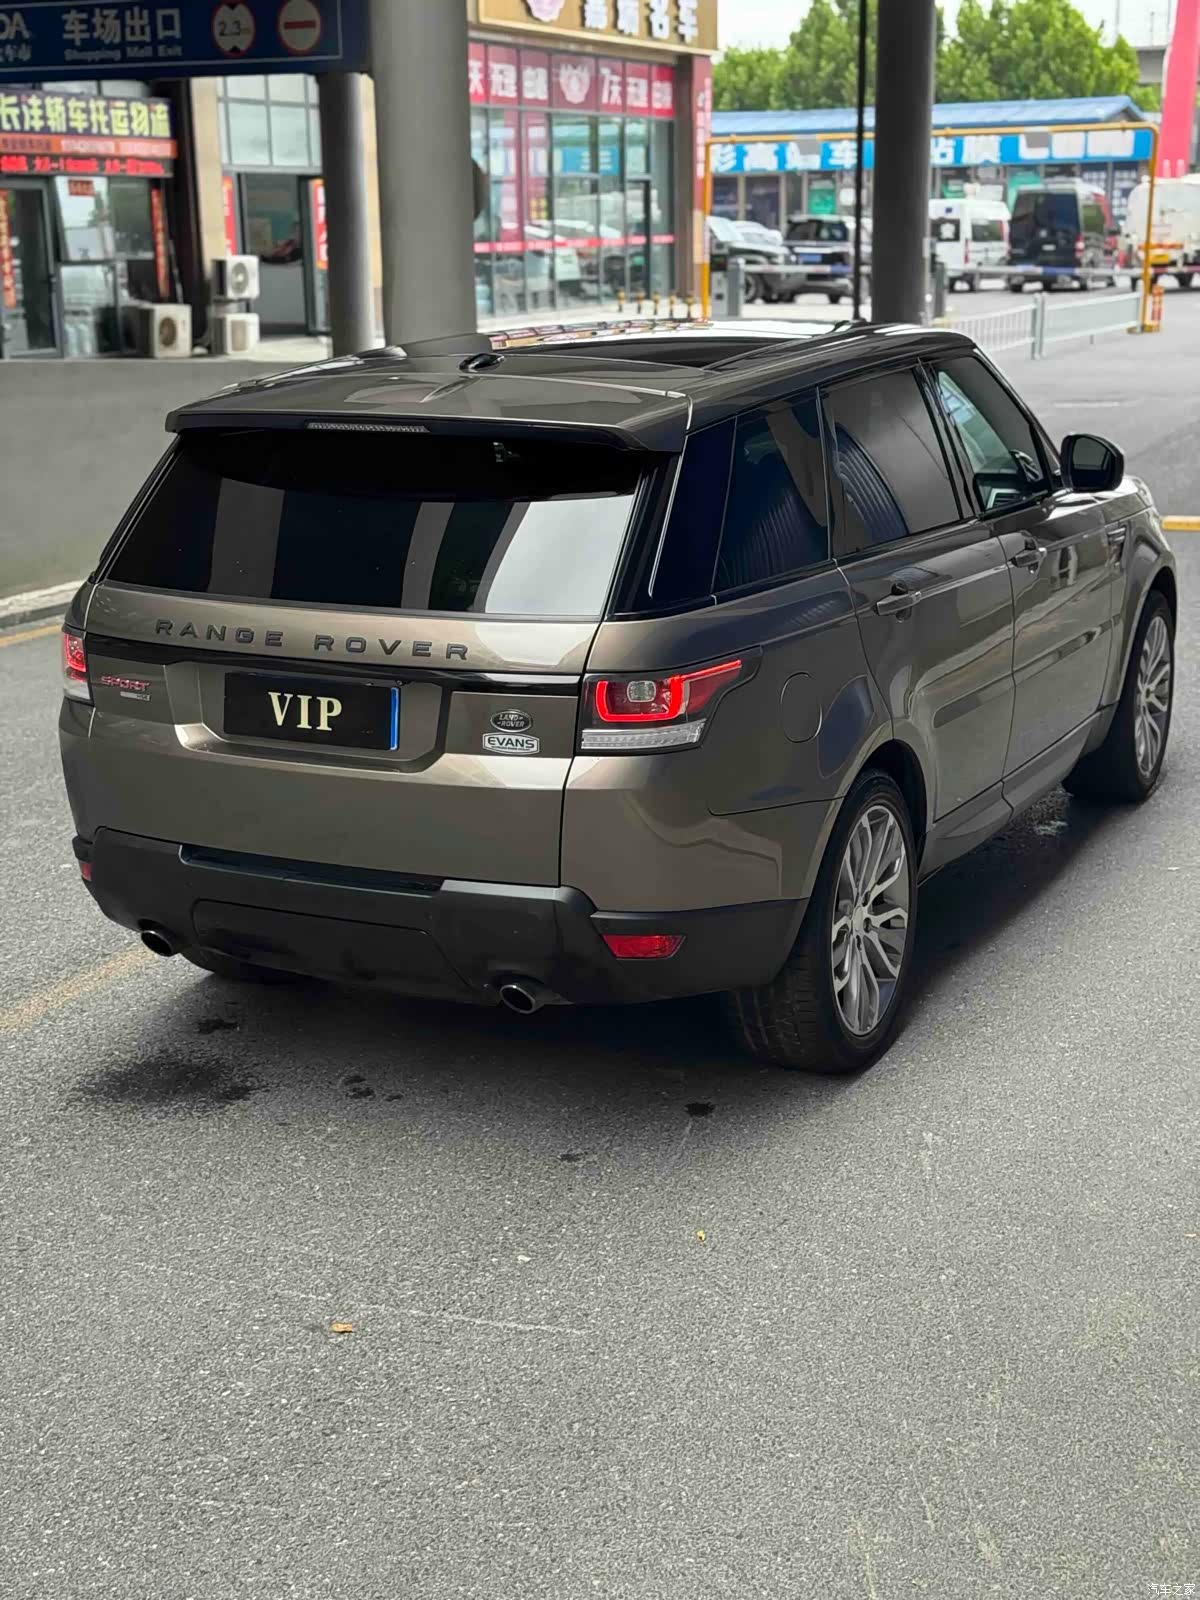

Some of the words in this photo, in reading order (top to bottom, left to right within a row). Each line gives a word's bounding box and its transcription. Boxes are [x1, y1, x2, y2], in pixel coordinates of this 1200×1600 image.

[62, 6, 183, 46] 车场出口
[157, 44, 184, 56] Exit
[155, 618, 284, 647] RANGE
[313, 634, 468, 660] ROVER
[101, 675, 150, 691] SPORT
[268, 691, 343, 732] VIP
[499, 713, 519, 721] LAND
[500, 720, 525, 728] ROVER
[487, 736, 535, 749] EVANS
